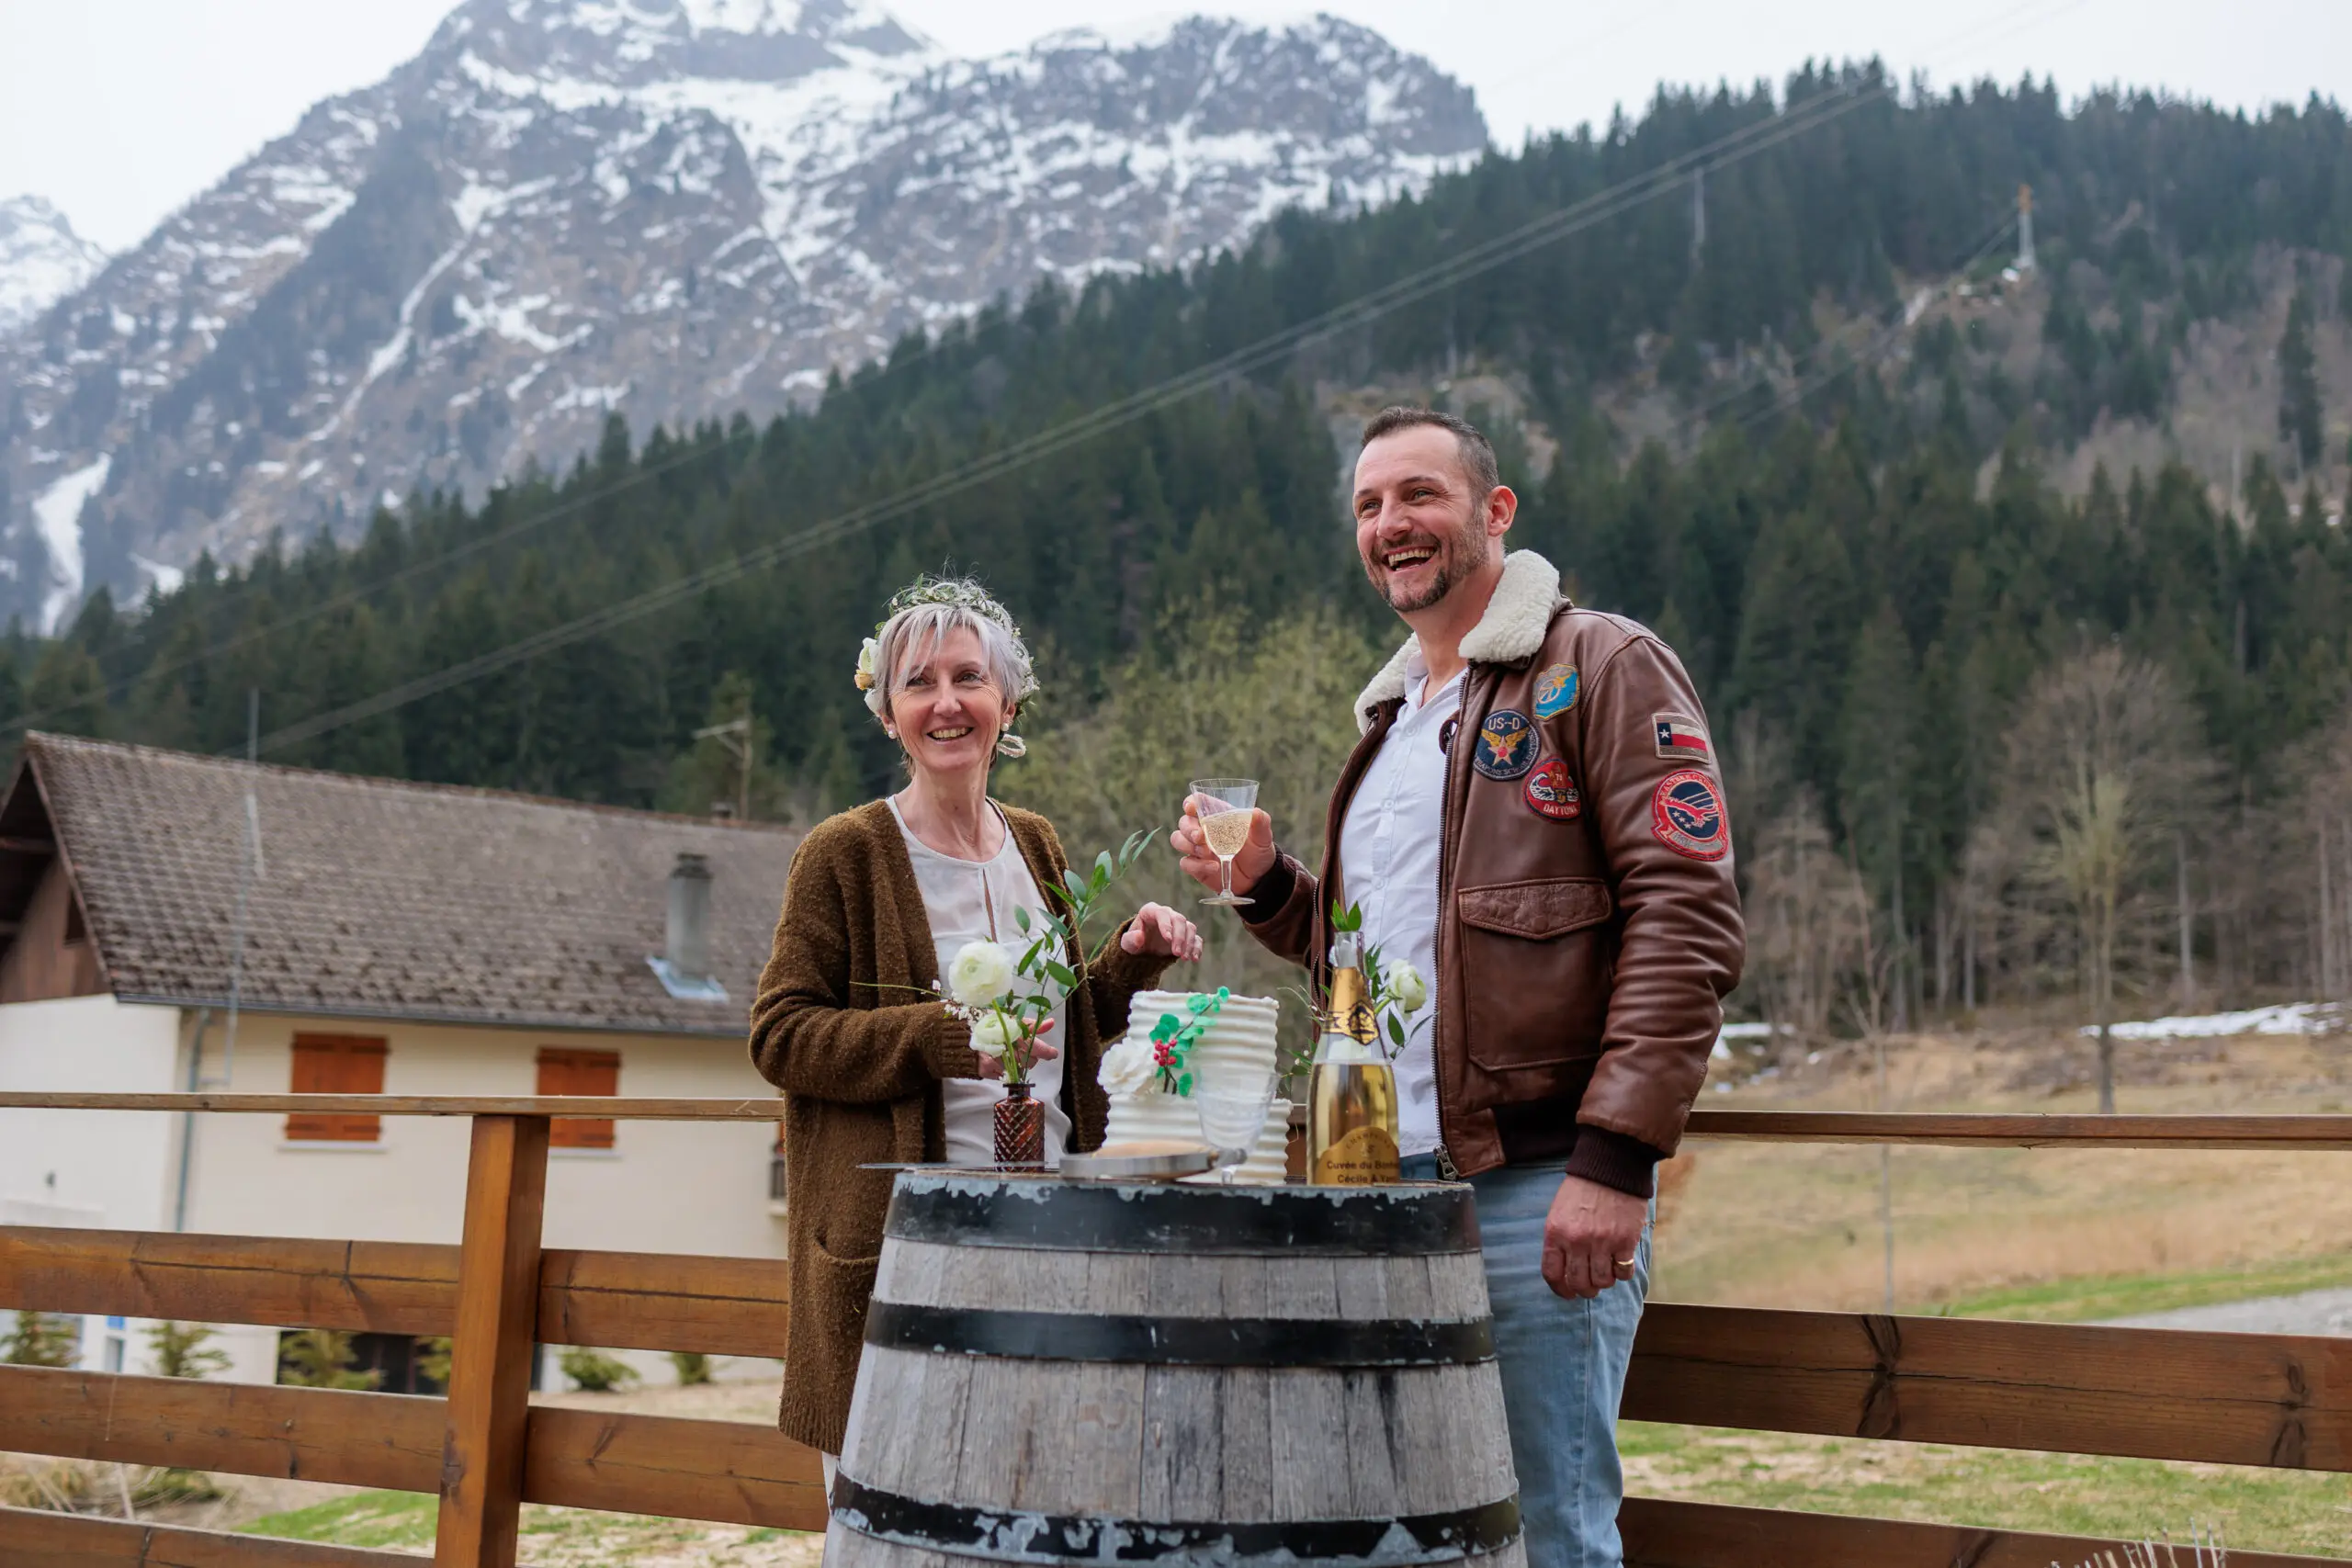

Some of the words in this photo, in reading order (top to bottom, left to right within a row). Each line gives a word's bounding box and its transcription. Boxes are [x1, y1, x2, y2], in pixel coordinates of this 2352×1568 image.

[1488, 717, 1521, 730] US-D
[1544, 803, 1578, 816] DAYTONA
[1327, 1160, 1357, 1169] Cuvée
[1360, 1160, 1372, 1169] du
[1338, 1175, 1368, 1183] Cécile
